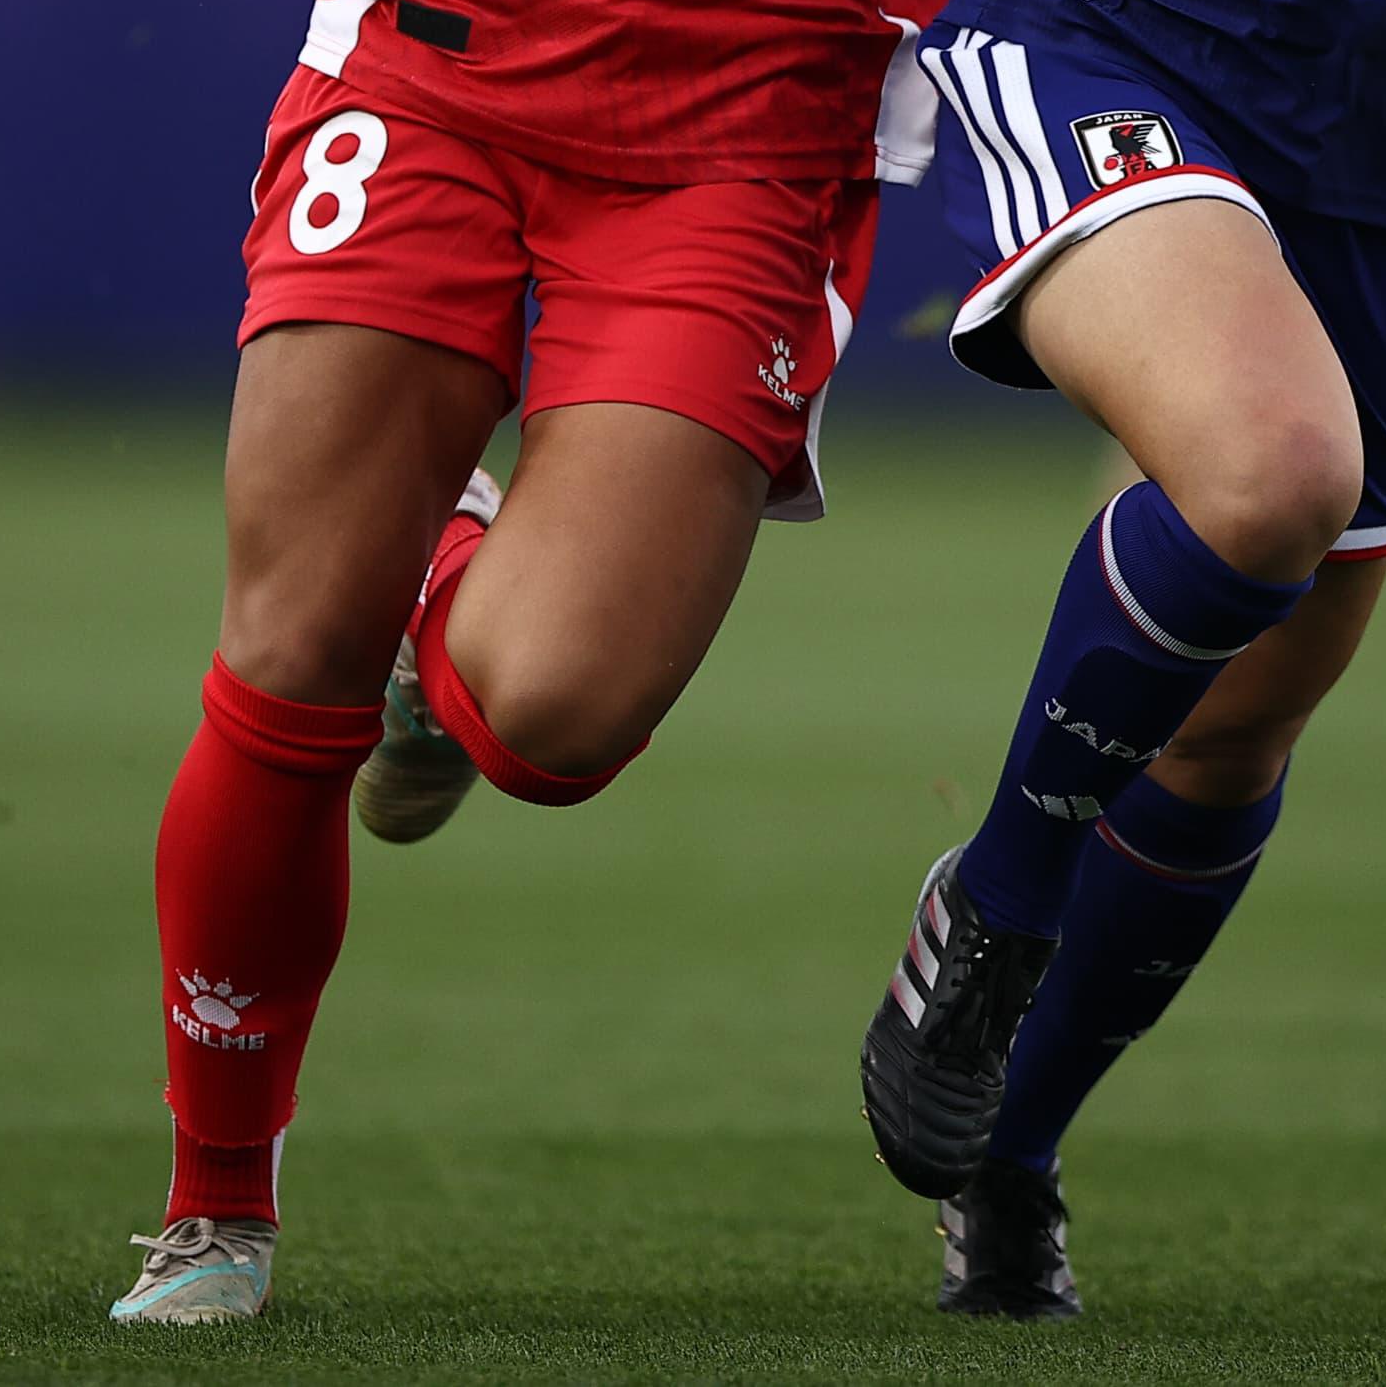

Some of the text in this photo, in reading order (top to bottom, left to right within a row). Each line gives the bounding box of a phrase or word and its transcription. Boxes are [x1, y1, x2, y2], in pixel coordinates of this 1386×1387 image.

[1095, 113, 1143, 125] JAPAN
[288, 111, 388, 255] 8
[758, 364, 805, 411] KELME
[1045, 697, 1173, 763] JAPA
[172, 1004, 265, 1050] KELME
